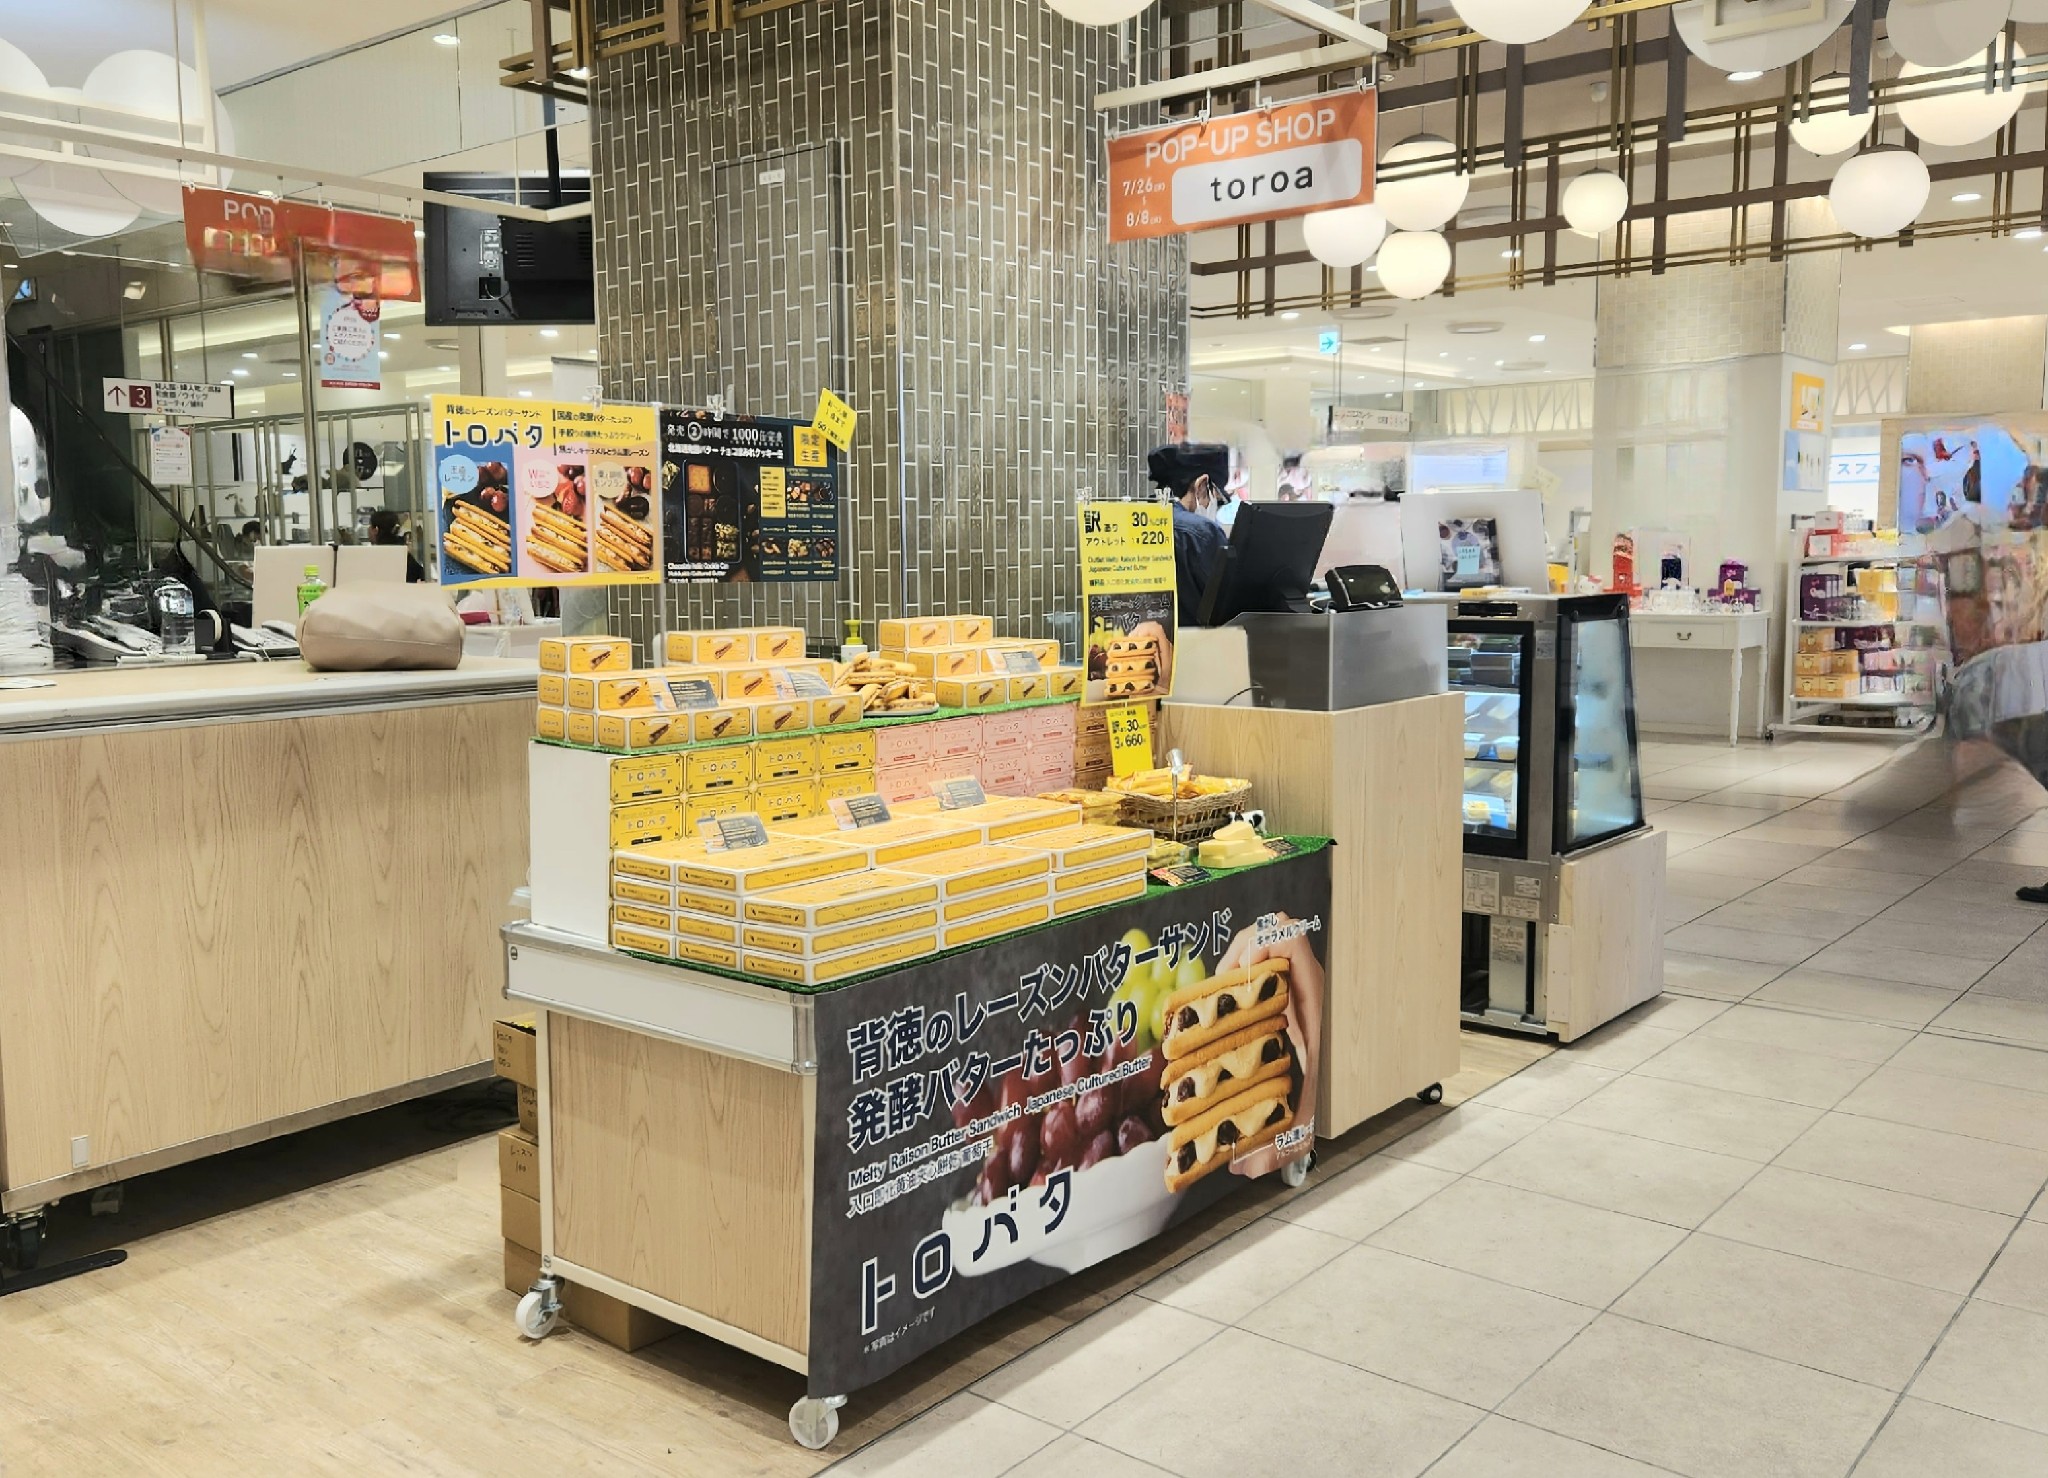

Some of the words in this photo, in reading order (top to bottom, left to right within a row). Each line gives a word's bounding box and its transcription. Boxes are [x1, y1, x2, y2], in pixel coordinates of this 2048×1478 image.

[1144, 125, 1248, 168] POP-UP
[1255, 108, 1336, 149] SHOP
[1211, 166, 1313, 202] toroa
[136, 388, 147, 407] 3
[444, 419, 544, 450] トロバタ
[1085, 537, 1126, 546] アウトレット
[847, 908, 1233, 1083] 背徳のレーズンバターサンド
[847, 999, 1140, 1152] 発酵バターたっぷり
[848, 1161, 887, 1191] Melty
[889, 1142, 930, 1173] Raison
[929, 1128, 968, 1156] Butter
[968, 1102, 1021, 1136] Sandwich
[1024, 1084, 1076, 1114] Japanese
[1076, 1068, 1122, 1094] Cultured
[1121, 1055, 1153, 1079] Butter
[860, 1170, 1072, 1334] トロバタ
